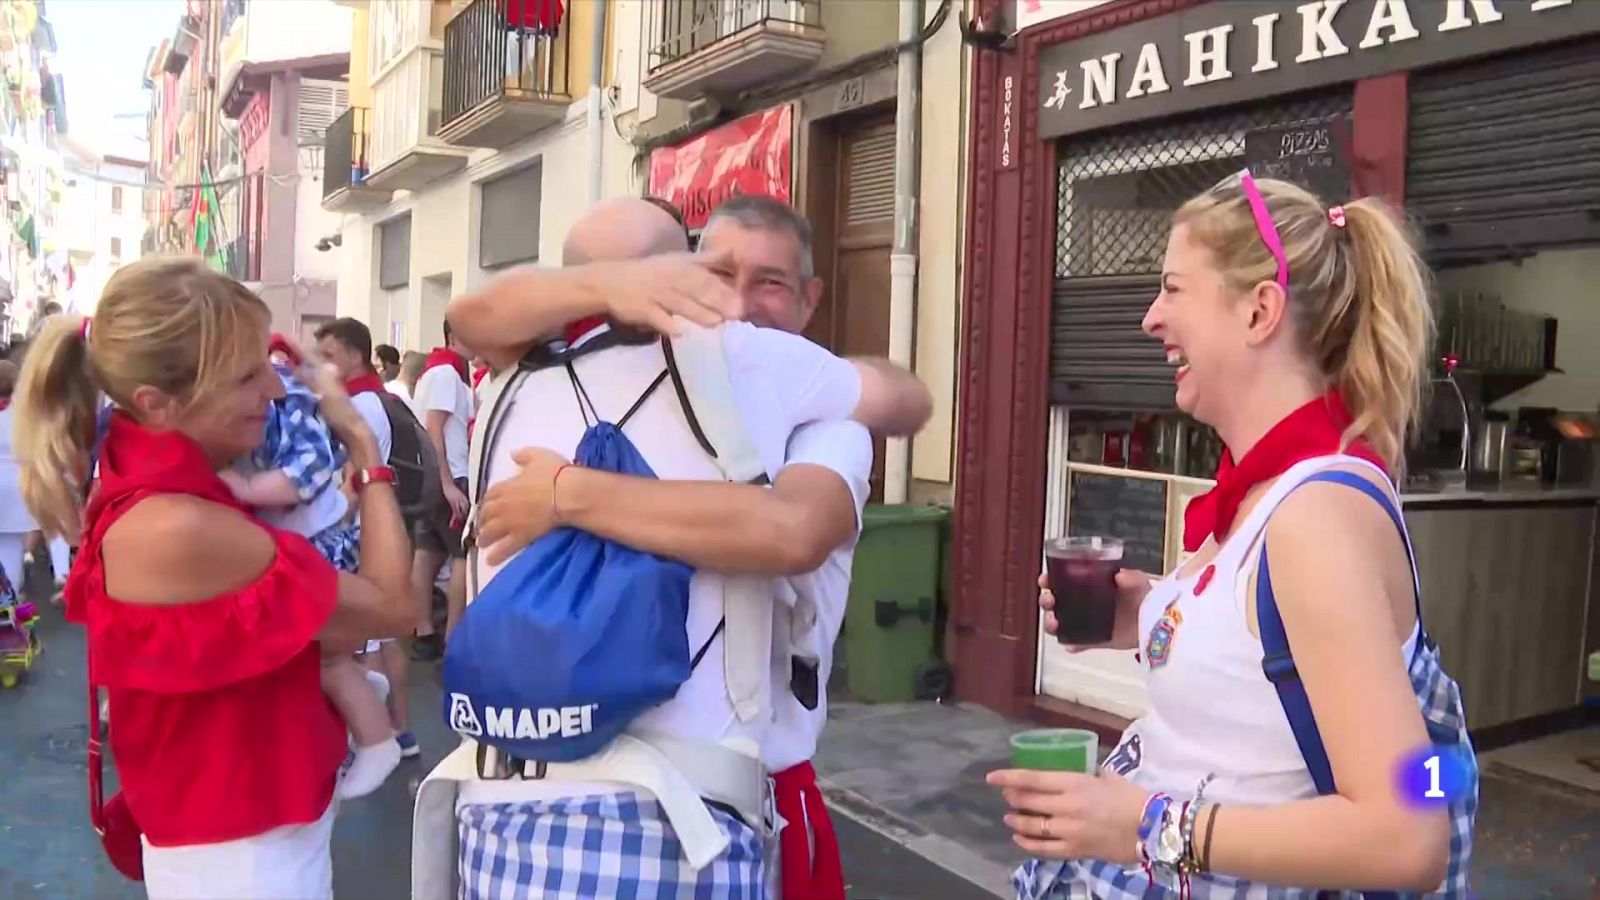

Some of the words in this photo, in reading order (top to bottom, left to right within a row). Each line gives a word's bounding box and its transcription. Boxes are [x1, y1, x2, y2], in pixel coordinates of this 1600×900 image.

[1079, 0, 1573, 109] NAHIKAR
[1002, 76, 1013, 167] BOKATAS
[485, 705, 594, 740] MAPEI
